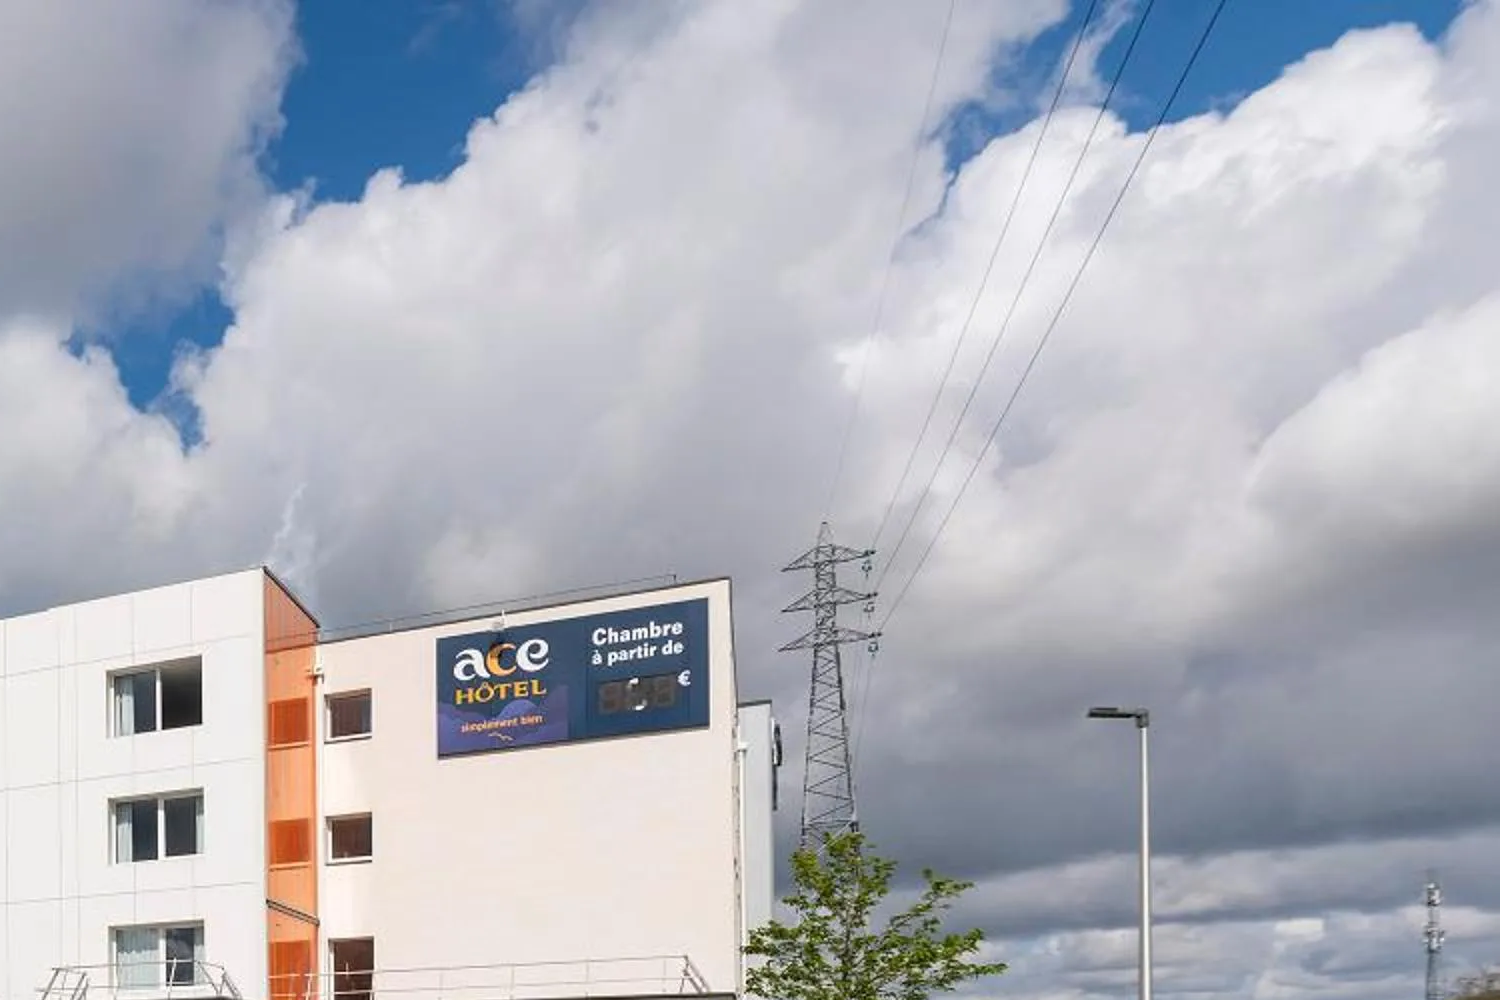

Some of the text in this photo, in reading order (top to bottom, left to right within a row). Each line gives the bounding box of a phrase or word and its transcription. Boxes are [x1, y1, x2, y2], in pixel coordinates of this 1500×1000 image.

[592, 621, 683, 645] Chambre
[453, 639, 549, 680] ace
[591, 640, 684, 666] à partir de
[678, 669, 691, 686] €
[454, 680, 547, 705] HÔTEL
